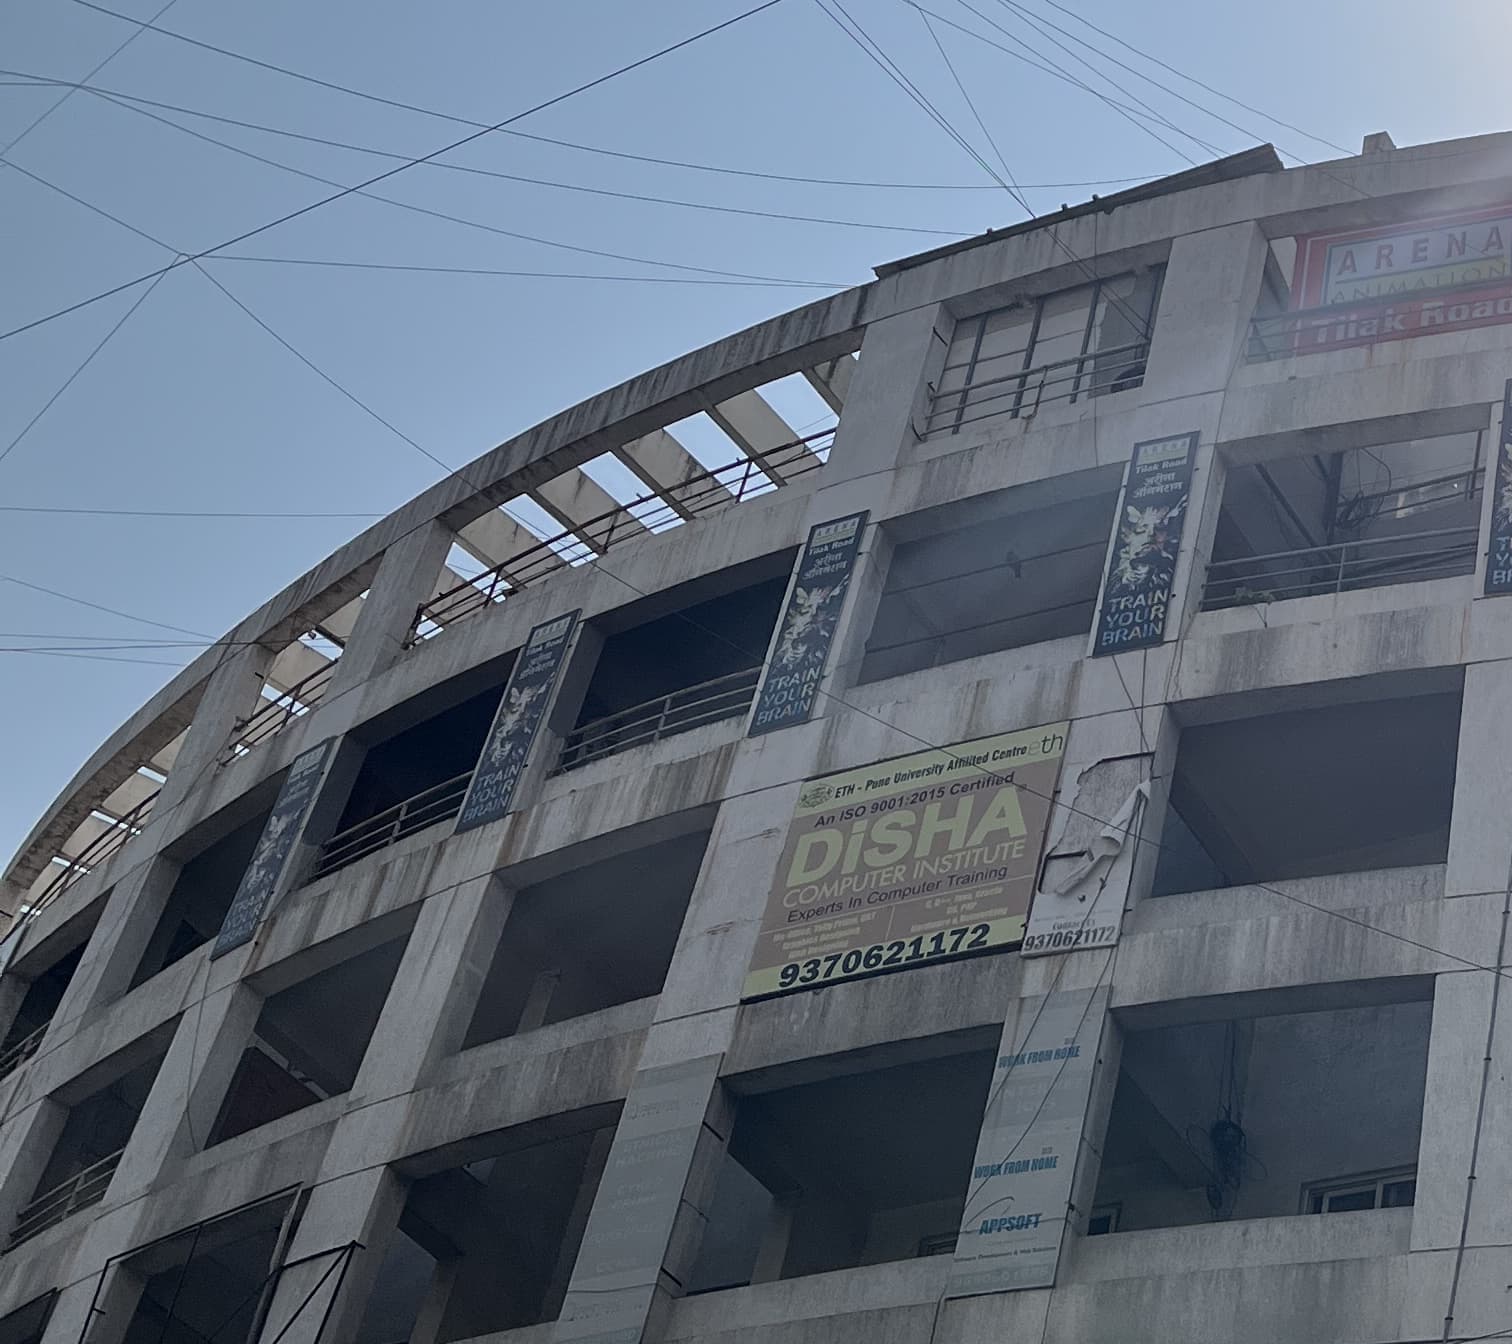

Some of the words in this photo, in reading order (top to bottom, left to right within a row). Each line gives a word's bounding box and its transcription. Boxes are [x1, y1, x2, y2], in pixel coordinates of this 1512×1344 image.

[1336, 225, 1506, 276] ARENA
[1331, 260, 1508, 304] ANIMATION
[1311, 307, 1407, 344] Tilak
[1108, 589, 1169, 613] TRAIN
[1105, 606, 1165, 628] YOUR
[1101, 621, 1163, 646] BRAIN
[768, 665, 821, 693] TRAIN
[764, 682, 816, 708] YOUR
[756, 699, 811, 726] BRAIN
[834, 781, 856, 799] ETH
[865, 776, 891, 792] Pune
[894, 763, 945, 785] University
[814, 815, 835, 828] An
[839, 805, 867, 822] ISO
[870, 783, 945, 814] 9001:2015
[950, 771, 1015, 796] Certified
[783, 866, 906, 908] COMPUTER
[913, 839, 1027, 879] INSTITUTE
[787, 901, 845, 924] Experts
[848, 896, 863, 909] In
[866, 881, 945, 908] Computer
[947, 866, 1008, 891] Training
[1023, 925, 1117, 952] 9370621172
[778, 923, 991, 988] 9370621172
[1026, 1048, 1054, 1065] FROM
[1002, 1160, 1031, 1176] FROM
[1031, 1155, 1060, 1171] HOME
[978, 1212, 1043, 1236] APPSOFT
